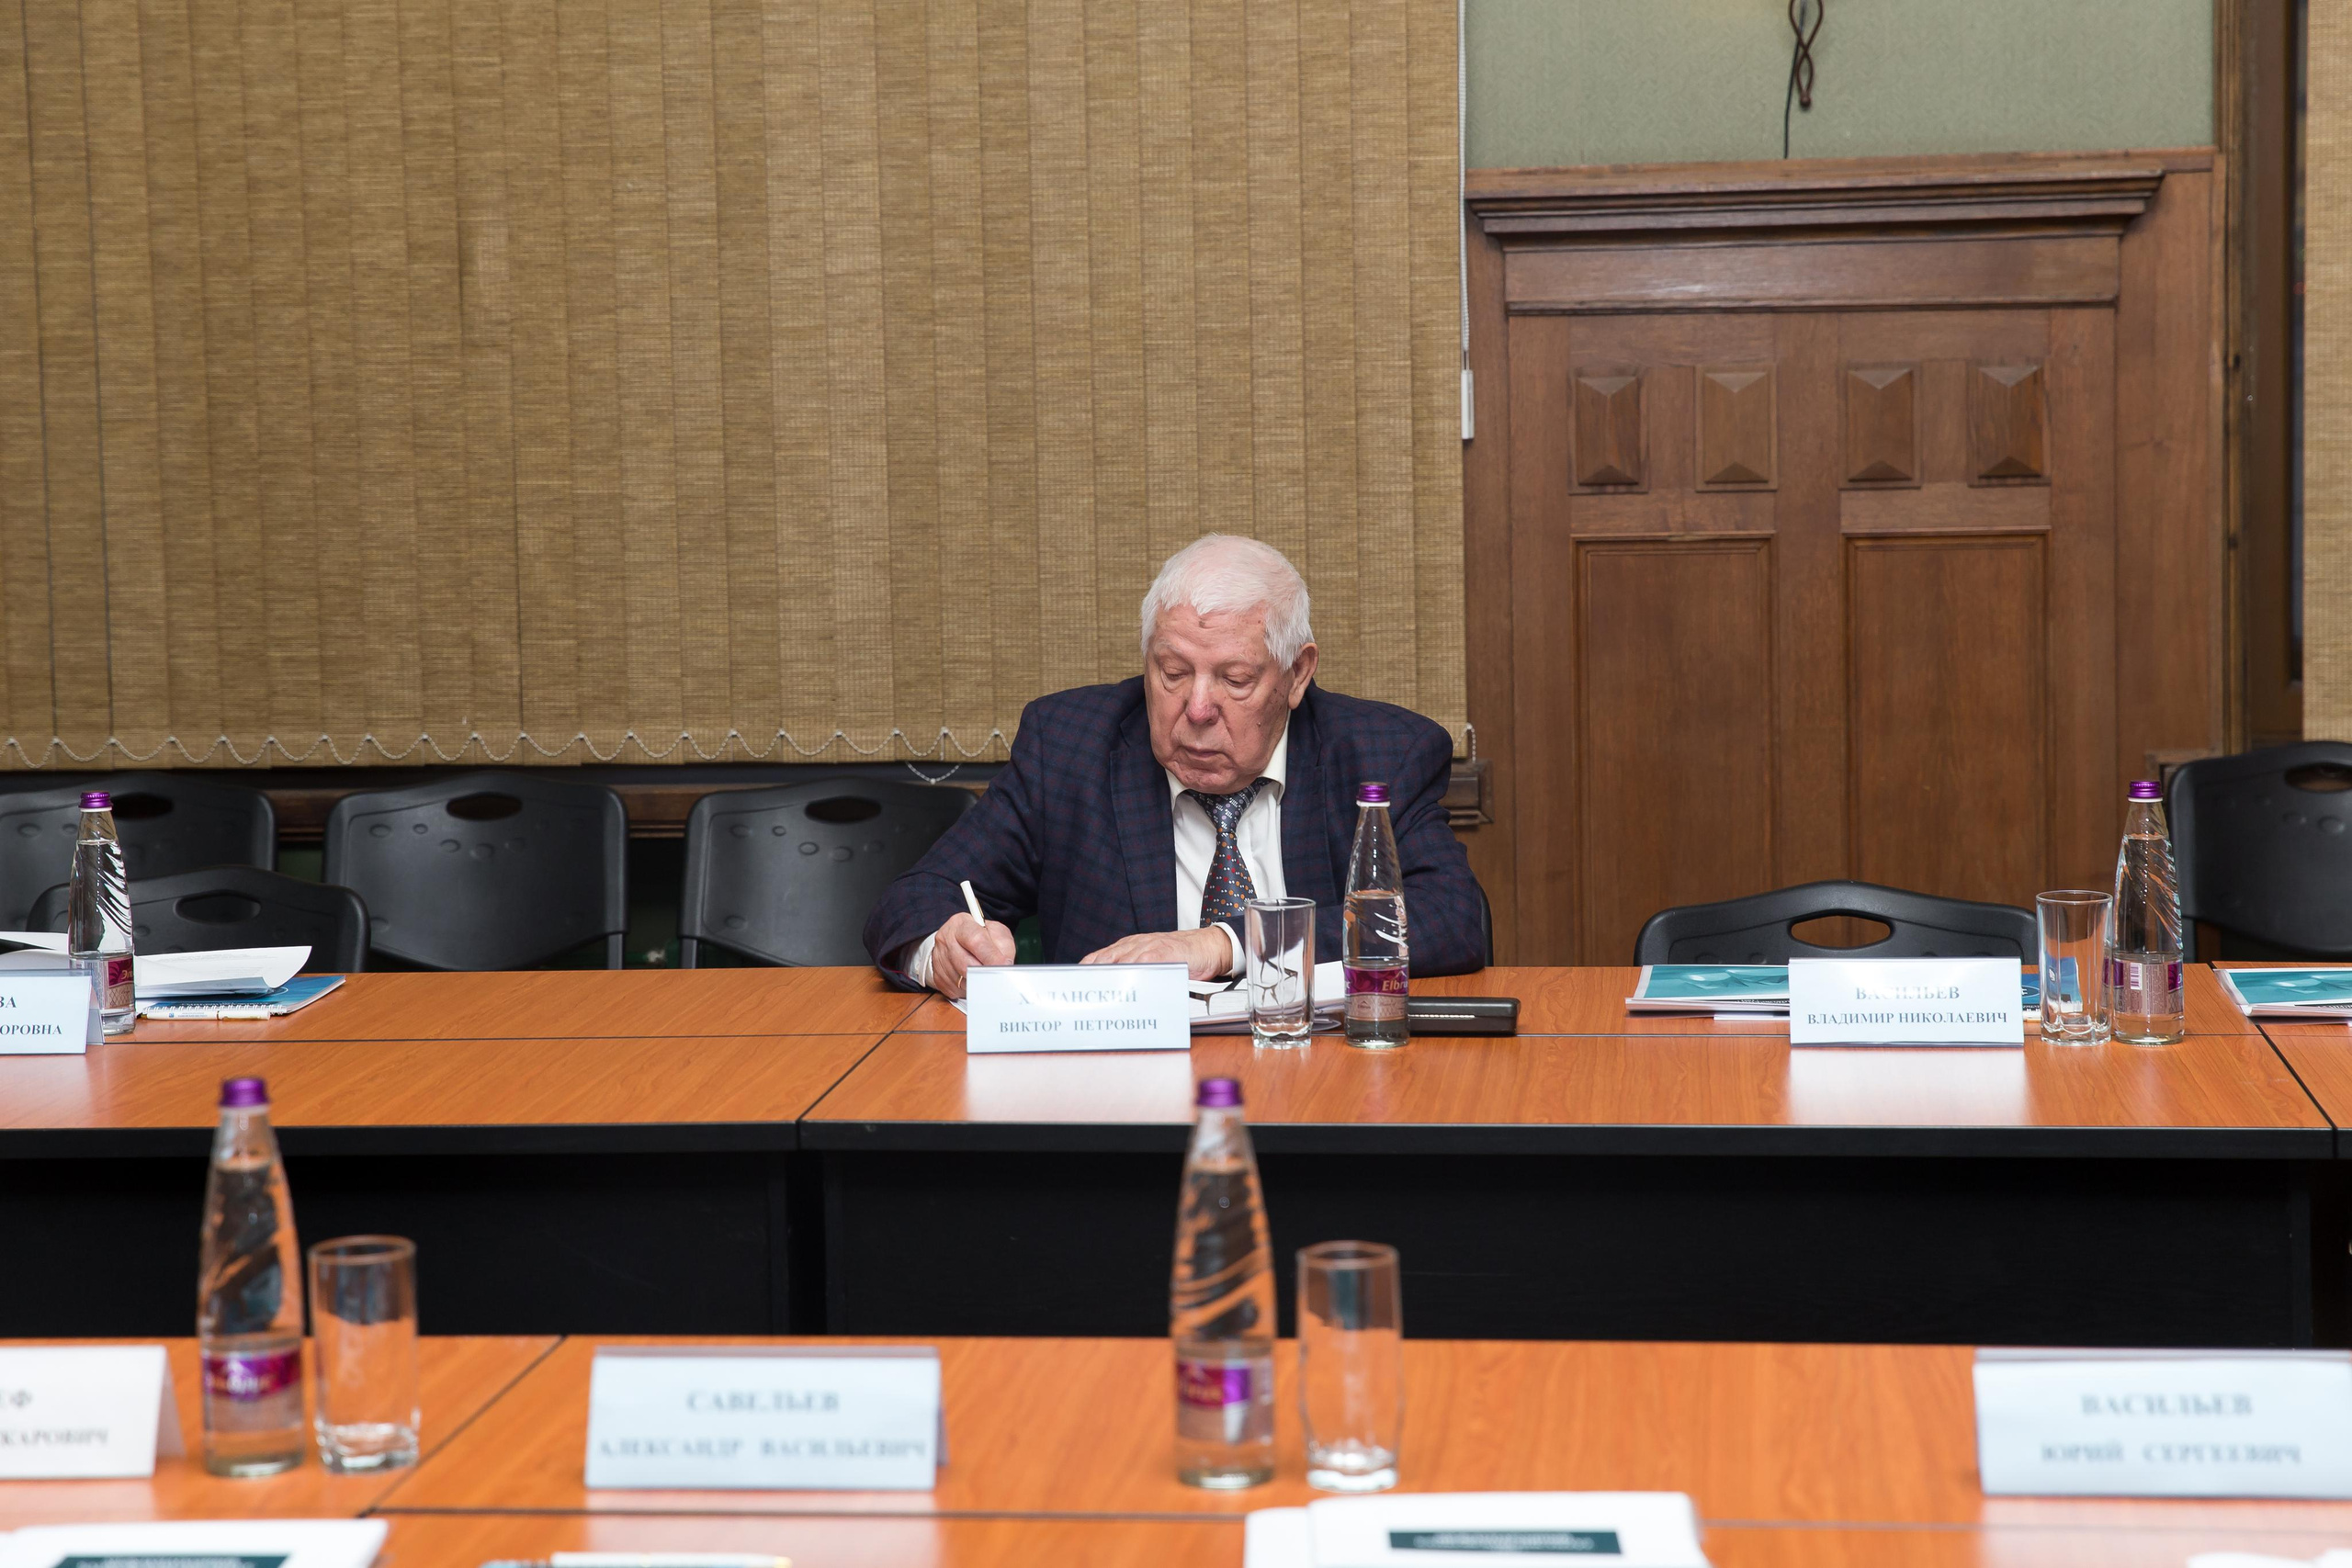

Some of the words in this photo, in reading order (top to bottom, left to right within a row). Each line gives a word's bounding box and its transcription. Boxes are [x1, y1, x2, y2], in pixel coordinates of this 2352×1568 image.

[1382, 979, 1408, 991] Elbru
[1019, 986, 1137, 1005] ХЛАНСКИЙ
[999, 1021, 1062, 1033] ВИКТОР
[1073, 1019, 1158, 1032] ПЕТРОВИЧ
[1807, 1012, 1894, 1025] ВЛАДИМИР
[1898, 1011, 2008, 1024] НИКОЛАЕВИЧ
[0, 1023, 62, 1035] ОРОВНА
[687, 1391, 840, 1412] САВЕЛЬЕВ
[2081, 1393, 2253, 1415] ВАСИЛЬЕВ
[0, 1428, 108, 1448] КАРОВИЧ
[600, 1438, 743, 1459] АЛЕКСАНДР
[759, 1438, 927, 1458] ВАСИЛЬЕВИЧ
[2041, 1438, 2124, 1462] ЮРИЙ
[2142, 1443, 2302, 1463] СЕРГЕЕВИЧ
